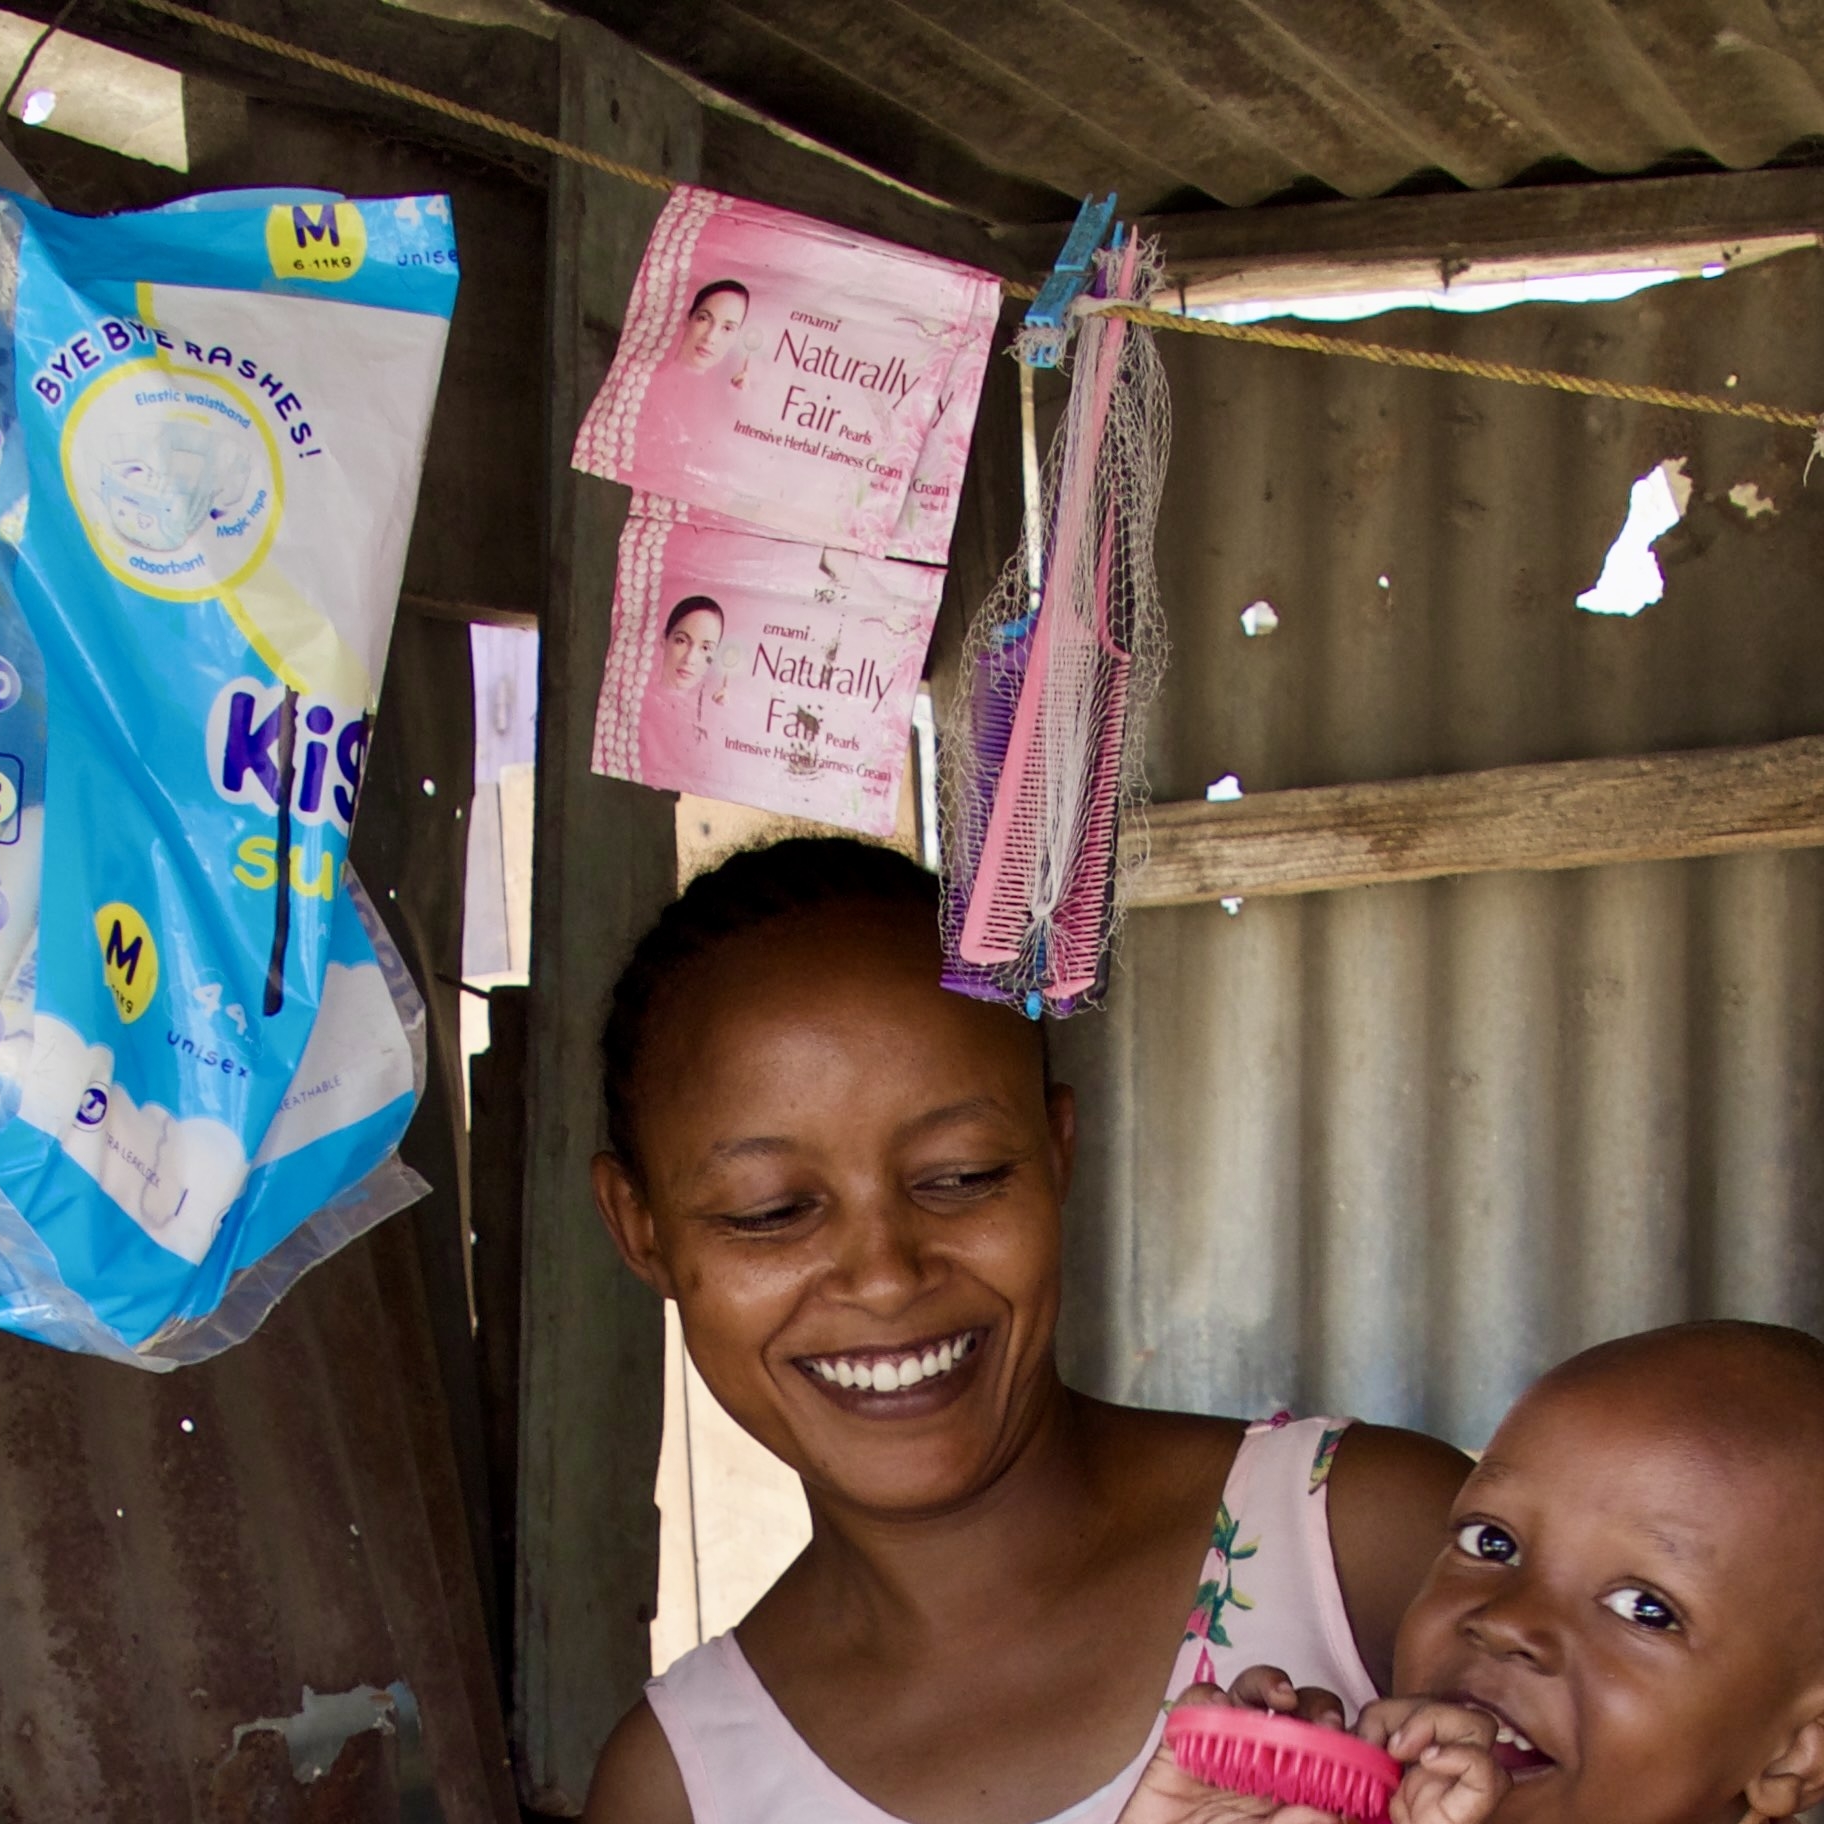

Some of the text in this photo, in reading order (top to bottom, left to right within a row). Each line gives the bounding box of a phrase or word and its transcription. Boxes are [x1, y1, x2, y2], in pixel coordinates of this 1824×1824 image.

[292, 204, 341, 248] M
[35, 337, 102, 406] BYE
[102, 318, 175, 352] BYE
[772, 327, 921, 411] Naturally
[134, 390, 253, 431] Elastic waistband
[780, 384, 874, 446] Fair Pearls
[733, 419, 783, 447] Intensive
[783, 435, 821, 456] Herbal
[865, 456, 903, 481] Cream
[912, 477, 951, 498] Cream
[215, 488, 268, 539] Magic tape
[128, 552, 206, 576] absorbent
[751, 642, 895, 714] Naturally
[724, 735, 893, 783] Intensive Cream
[105, 918, 144, 988] M
[166, 1031, 251, 1079] unisex
